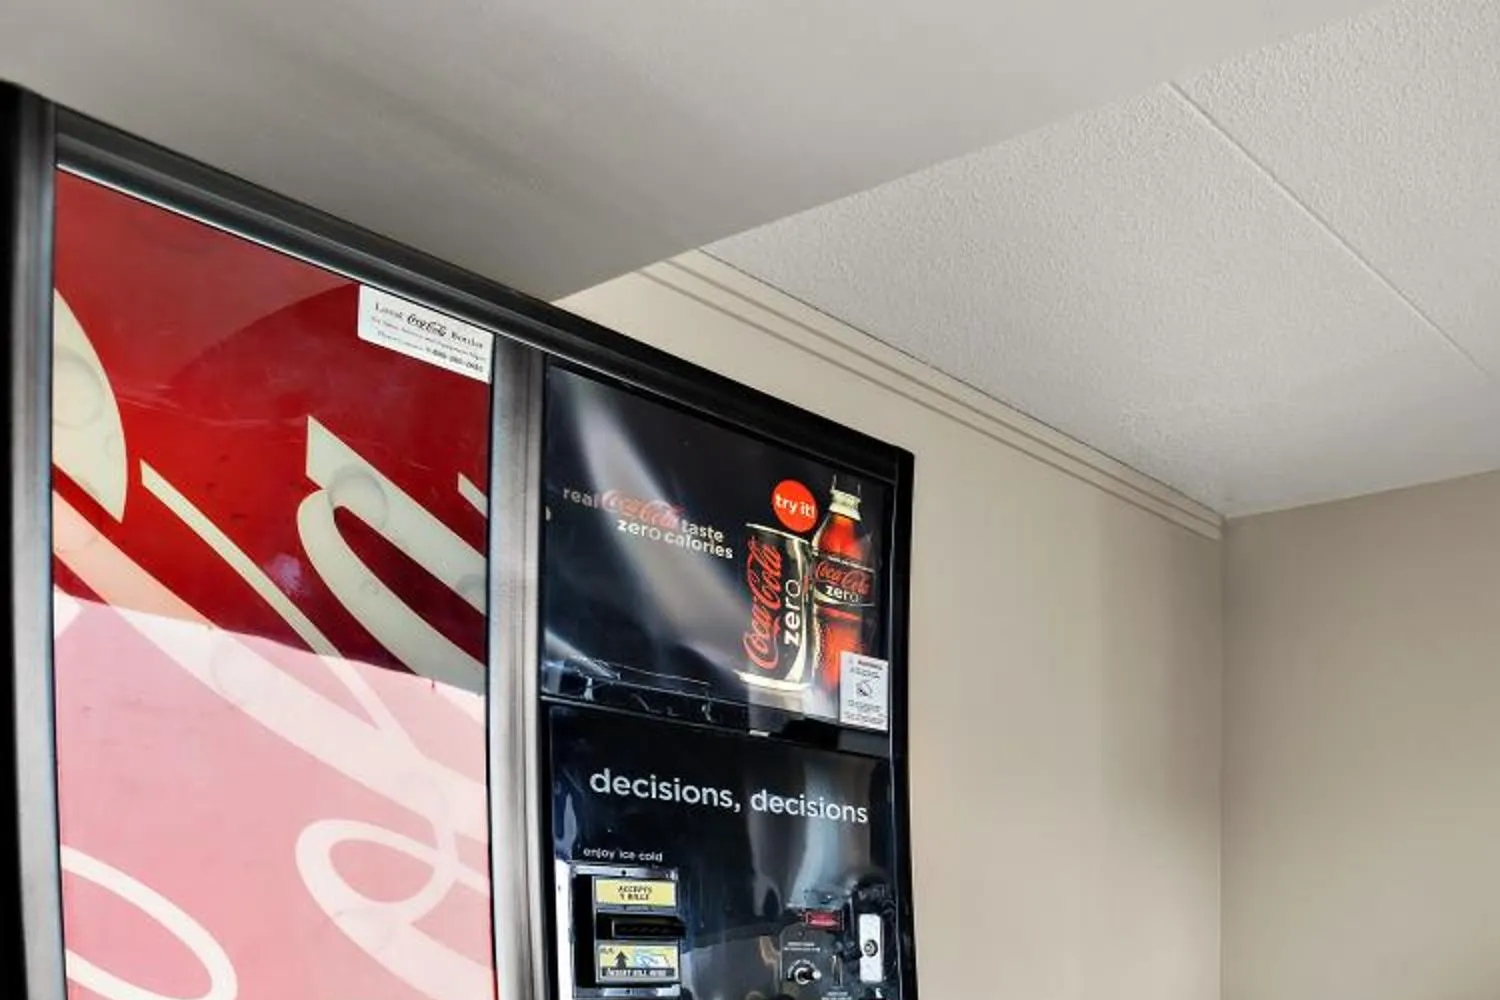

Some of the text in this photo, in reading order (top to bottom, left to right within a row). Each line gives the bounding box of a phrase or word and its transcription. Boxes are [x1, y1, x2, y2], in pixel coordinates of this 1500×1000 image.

[563, 488, 600, 508] real
[681, 519, 724, 543] taste
[774, 495, 816, 517] try it!
[616, 519, 733, 559] zero calories
[784, 579, 801, 645] zero
[826, 584, 863, 602] zero
[589, 768, 869, 825] decisions, decisions
[583, 848, 663, 863] enjoy ice cold
